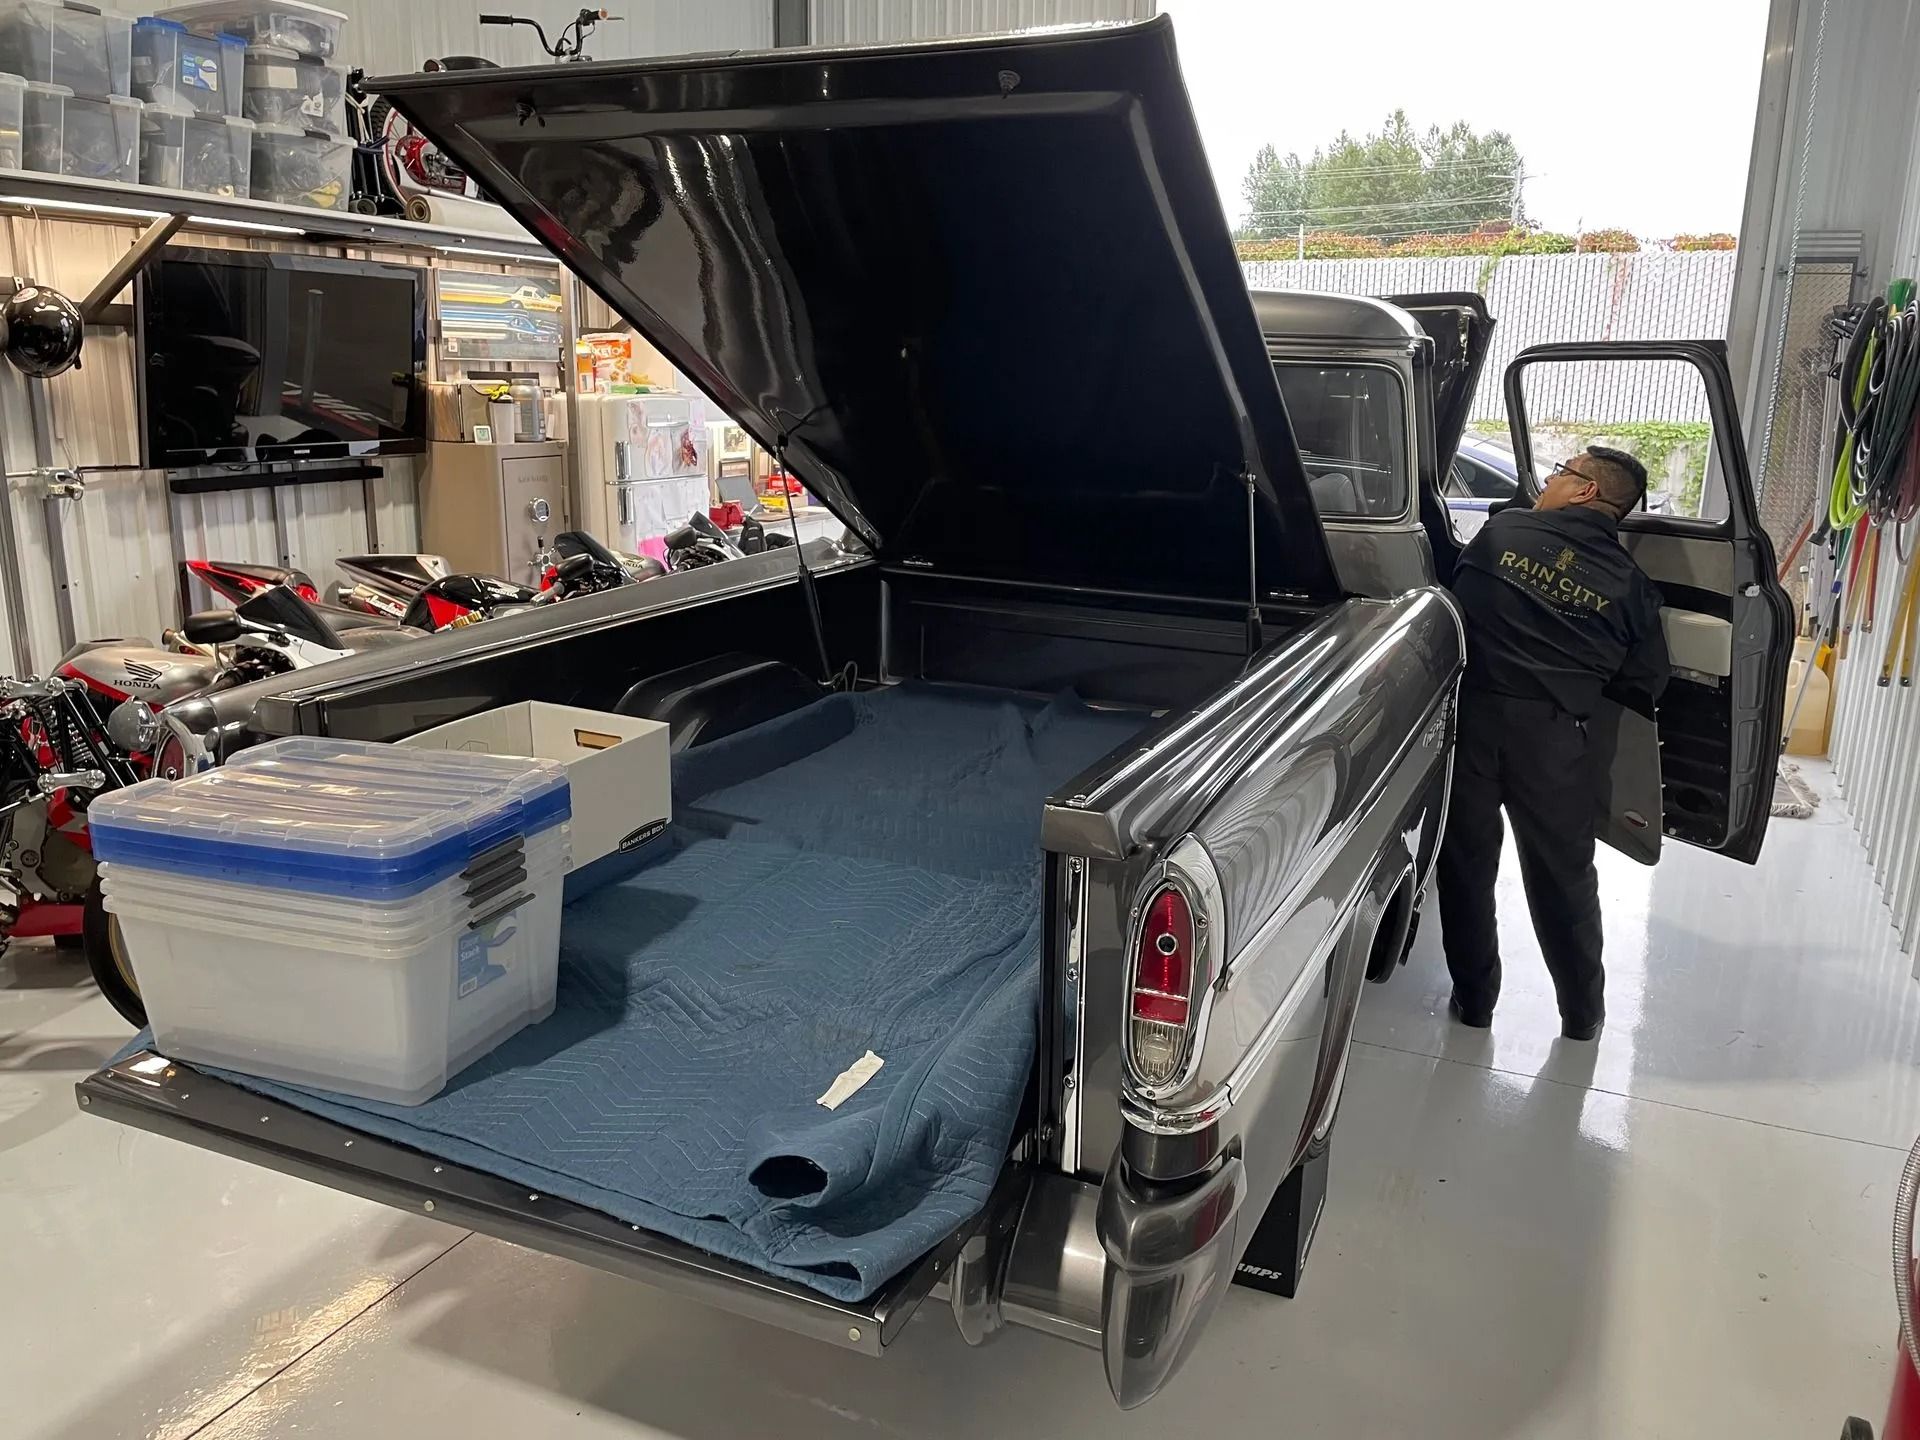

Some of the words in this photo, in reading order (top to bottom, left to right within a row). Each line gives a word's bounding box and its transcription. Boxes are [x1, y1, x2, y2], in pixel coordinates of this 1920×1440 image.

[1499, 551, 1556, 583] RAIN
[1559, 577, 1611, 611] CITY
[1520, 572, 1581, 607] GARAGE
[113, 679, 161, 690] HONDA
[622, 830, 651, 849] BANKERS
[651, 823, 664, 835] BOX
